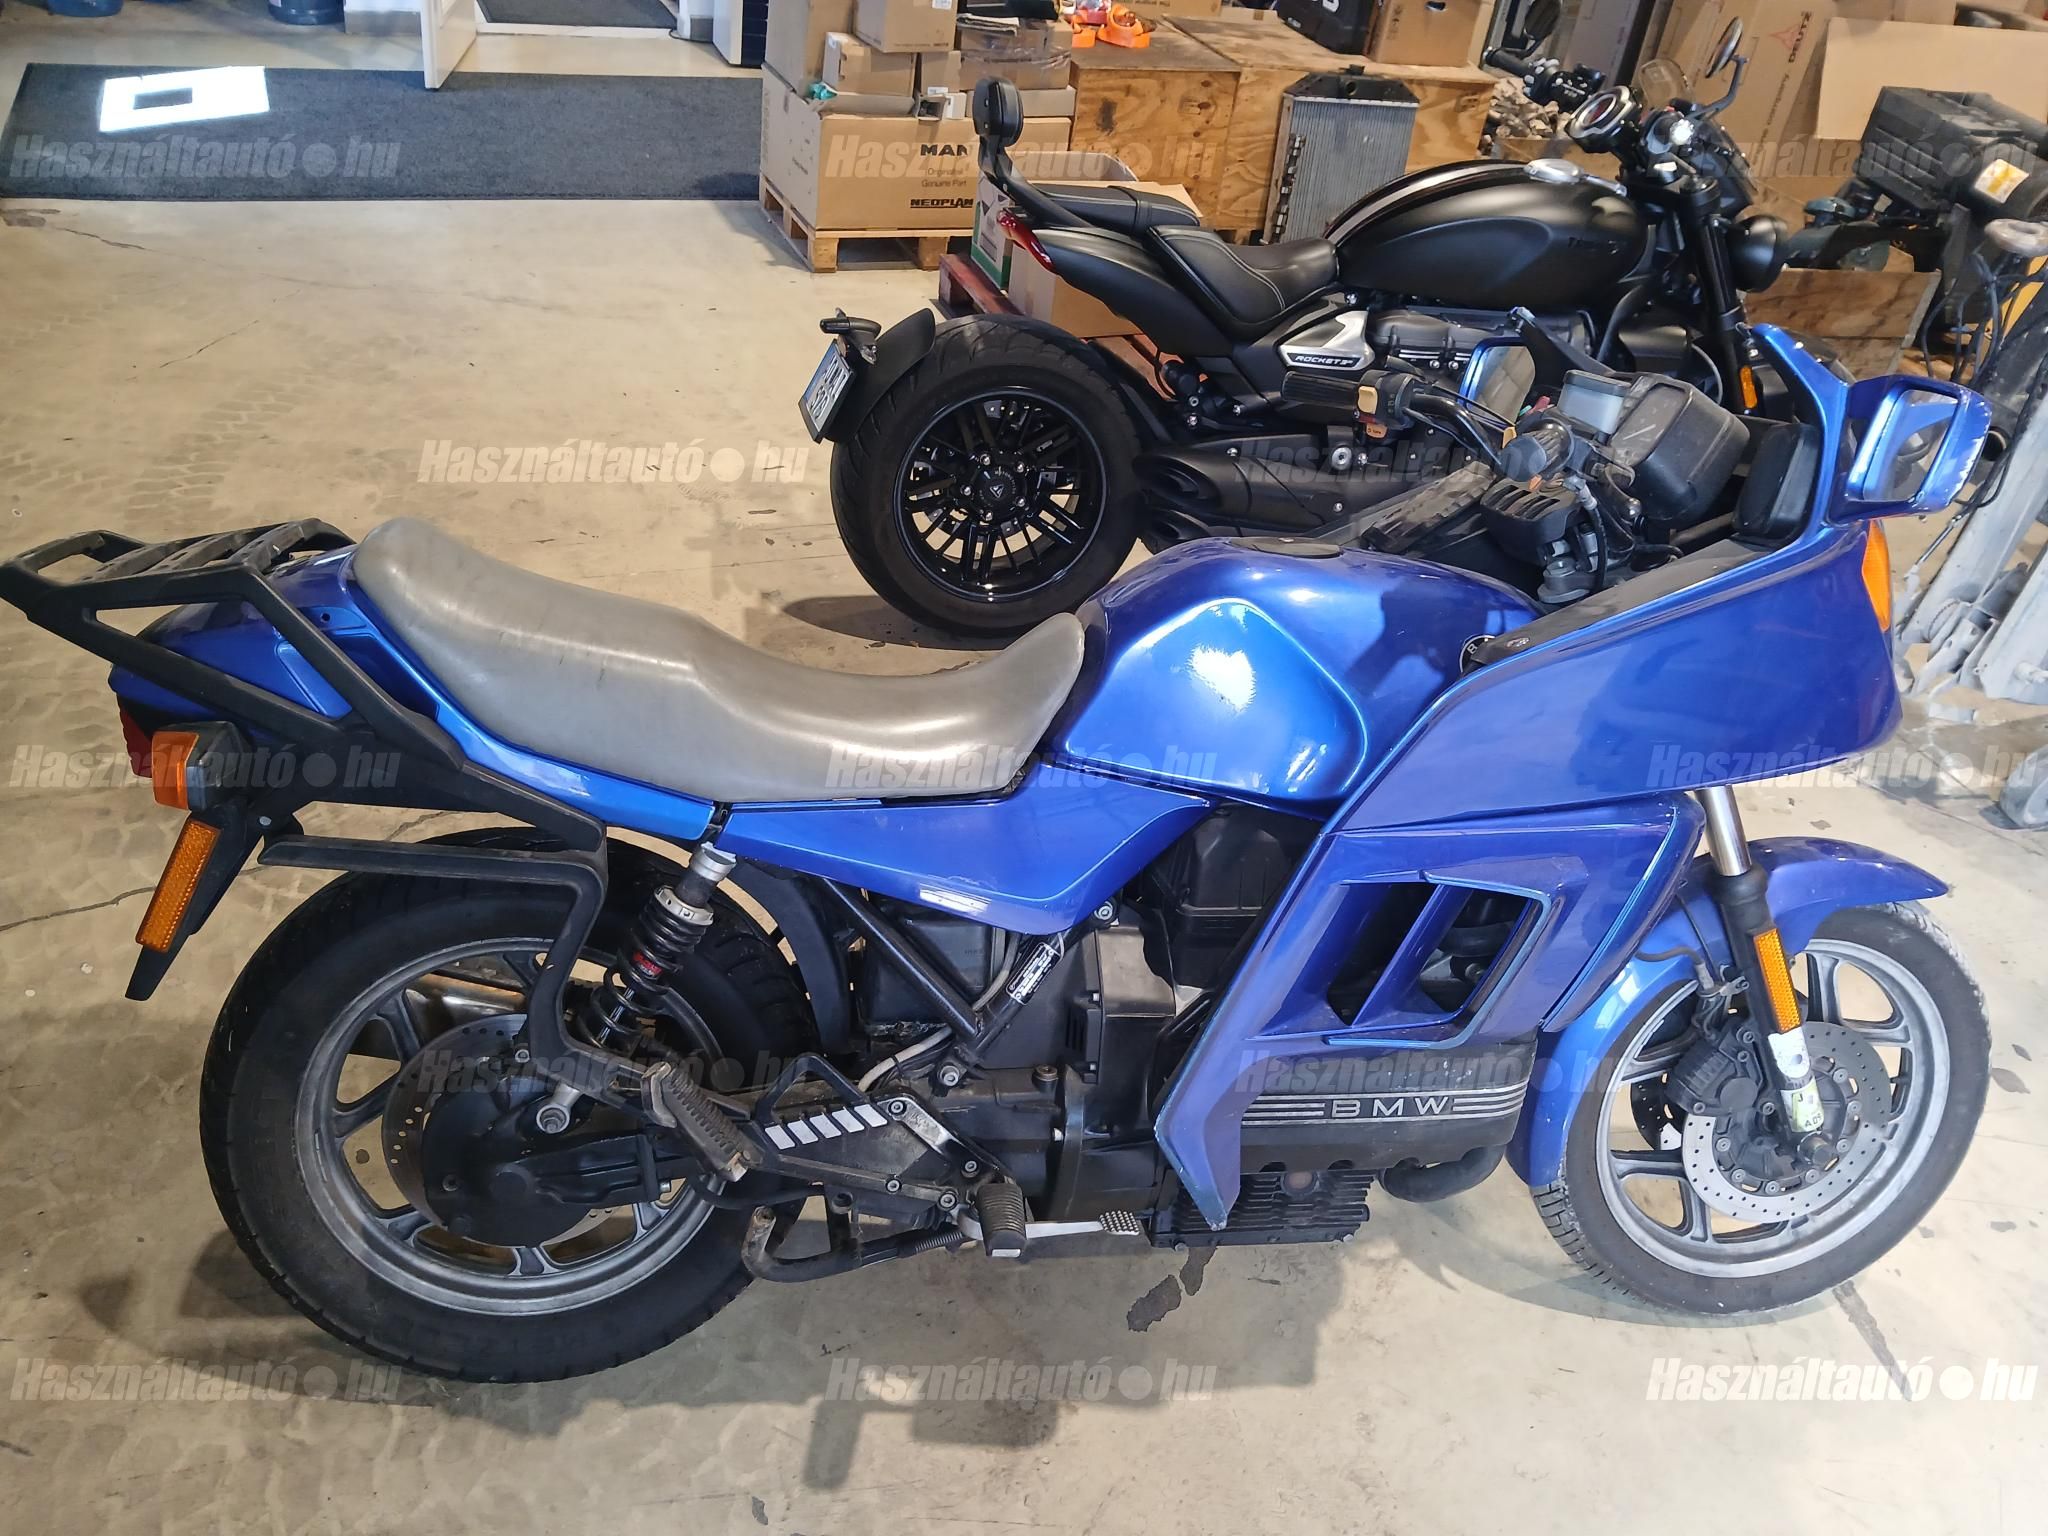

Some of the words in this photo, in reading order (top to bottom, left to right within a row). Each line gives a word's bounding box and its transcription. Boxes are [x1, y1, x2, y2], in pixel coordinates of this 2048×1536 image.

[919, 144, 968, 156] MAN
[910, 197, 974, 208] NEOPLAN
[1332, 1096, 1448, 1118] BMW
